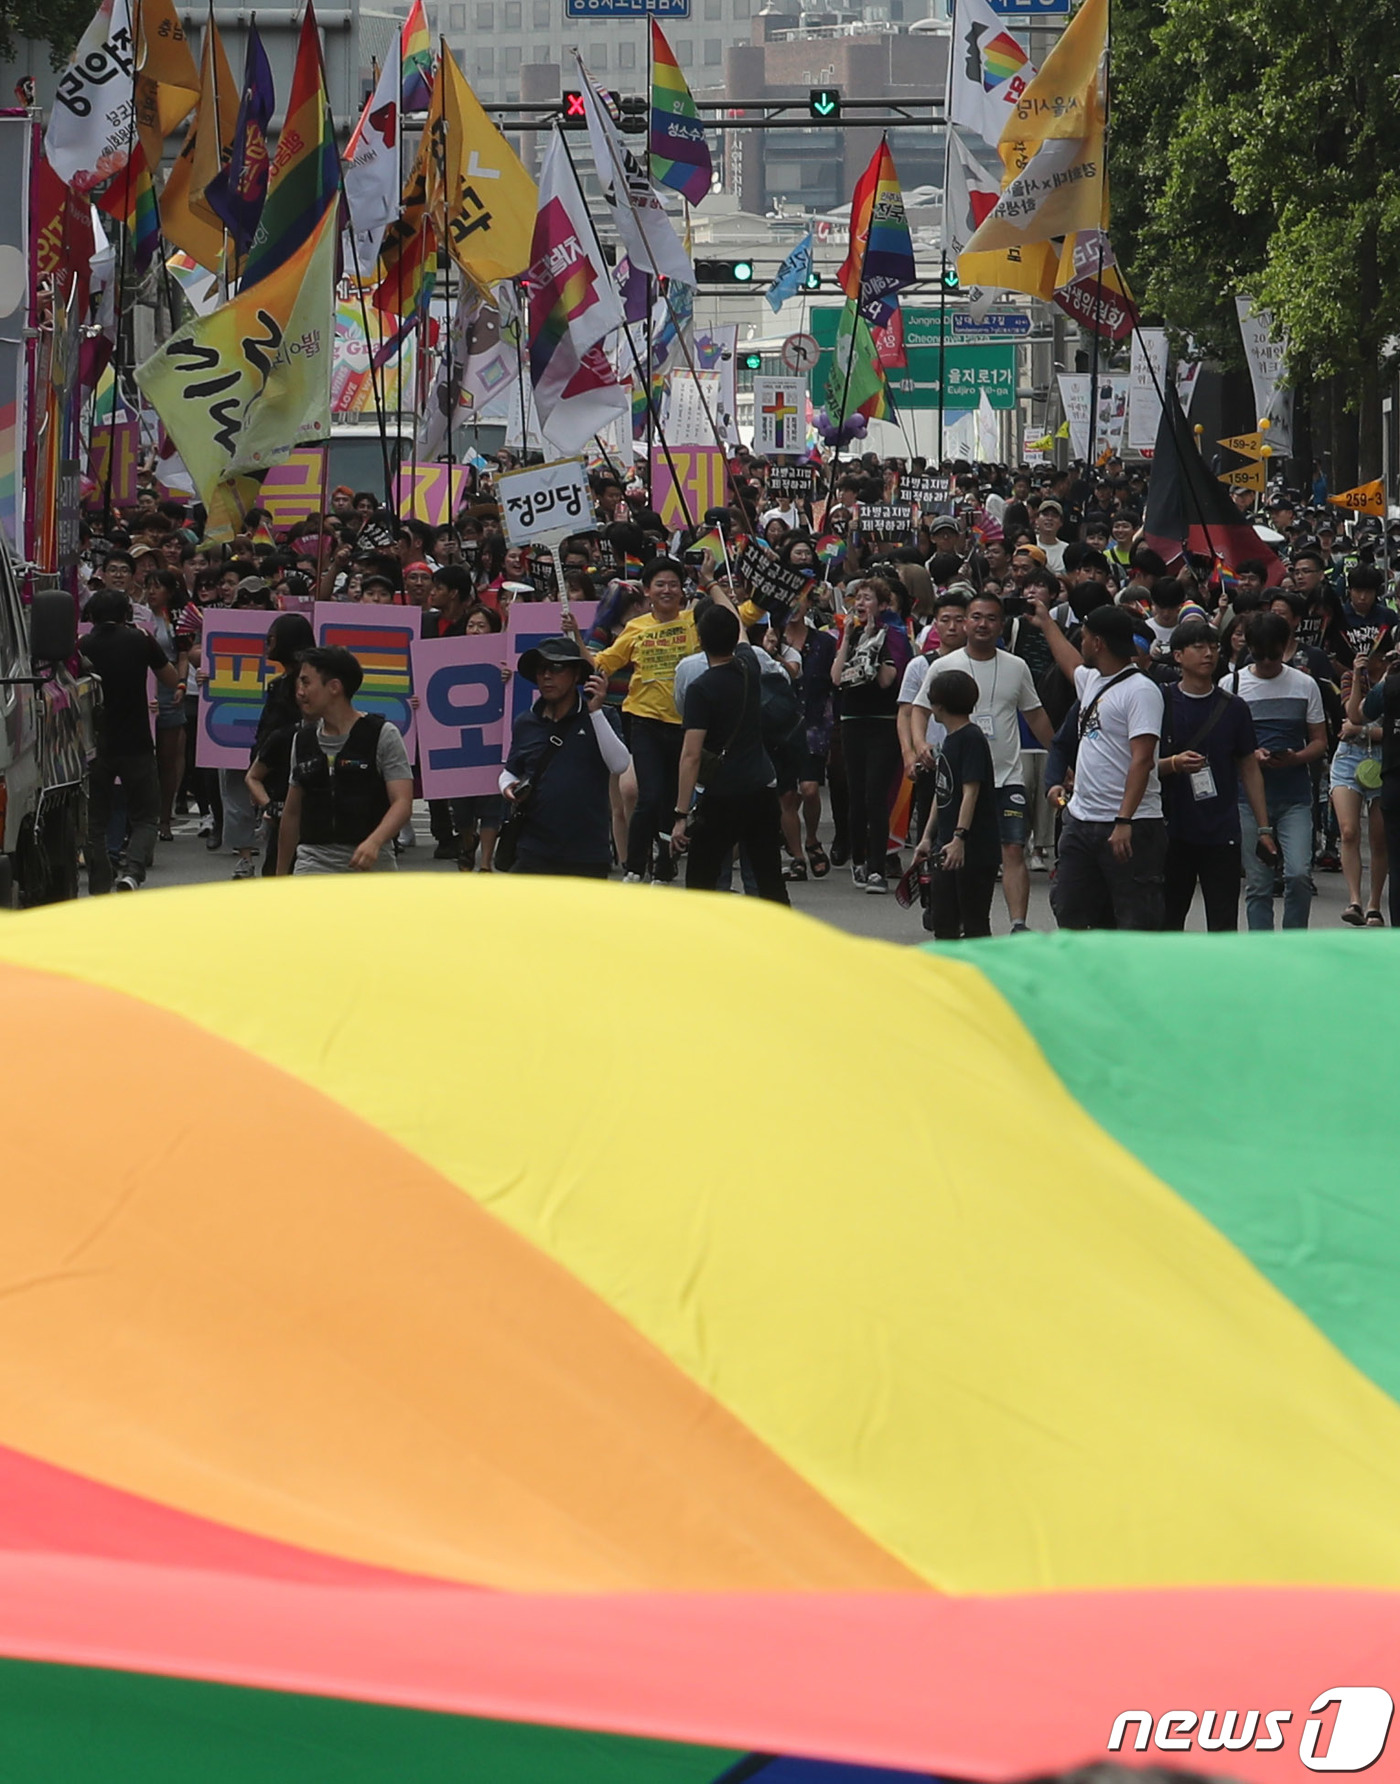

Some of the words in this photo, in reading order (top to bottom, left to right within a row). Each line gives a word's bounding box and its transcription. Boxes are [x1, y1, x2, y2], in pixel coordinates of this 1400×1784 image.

[955, 316, 1005, 326] 남대로7길
[948, 369, 1013, 385] 을지로1가
[340, 382, 358, 410] LOVE
[947, 385, 976, 396] Euljiro
[1228, 439, 1257, 450] 159-2
[900, 475, 949, 490] 차별금지법
[1229, 473, 1260, 484] 159-1
[657, 452, 725, 526] 제
[900, 489, 948, 502] 제정하라!
[506, 483, 582, 527] 정의당
[1345, 492, 1383, 508] 259-3
[860, 505, 911, 518] 차별금지법
[862, 519, 910, 531] 제정하라!
